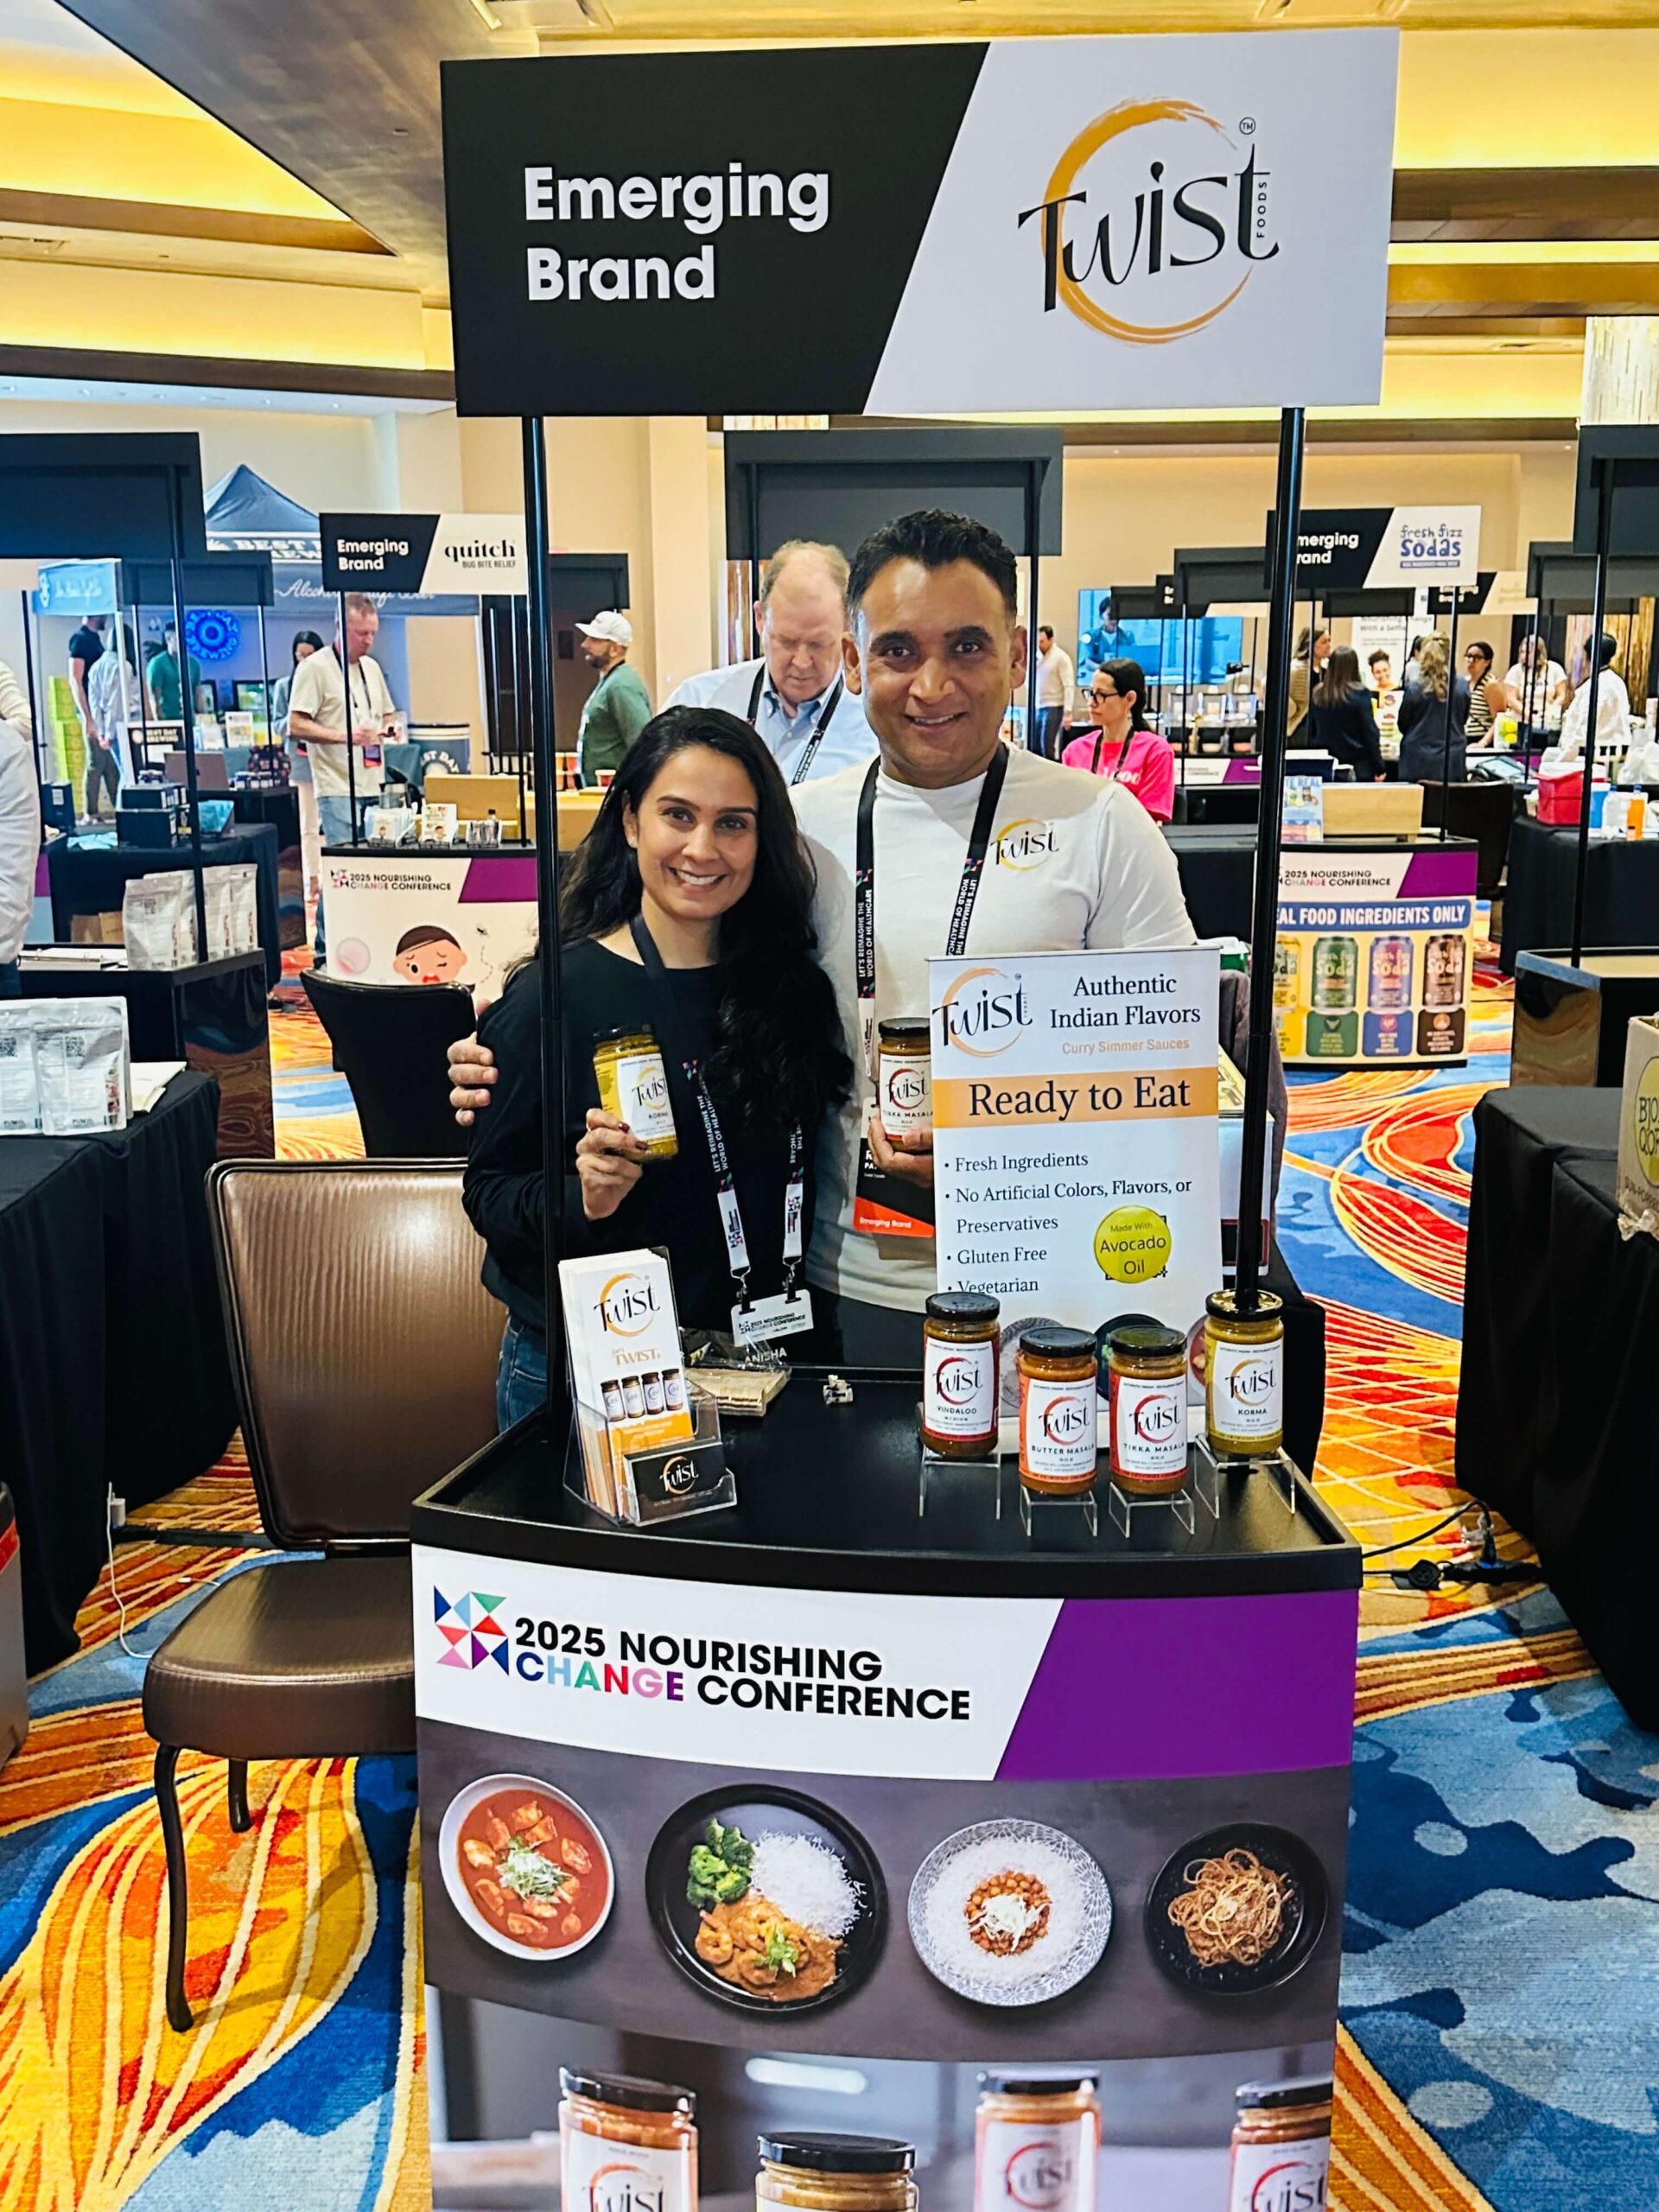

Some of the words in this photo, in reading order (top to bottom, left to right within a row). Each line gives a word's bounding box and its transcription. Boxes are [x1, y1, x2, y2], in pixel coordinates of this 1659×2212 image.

[524, 162, 829, 234] Emerging
[1256, 181, 1268, 238] FOODS
[1018, 143, 1280, 312] Twist
[527, 245, 715, 301] Brand
[1298, 532, 1359, 549] merging
[1401, 524, 1434, 538] fresh
[1438, 524, 1463, 537] fizz
[337, 539, 409, 556] Emerging
[444, 539, 516, 563] quitch
[1296, 550, 1332, 564] rand
[339, 556, 385, 571] Brand
[494, 560, 516, 569] RELIEF
[990, 829, 1059, 865] Twist
[373, 874, 431, 882] NOURISHING
[957, 879, 969, 905] WORLD
[954, 906, 963, 916] OF
[1276, 908, 1296, 925] AL
[1300, 908, 1336, 925] FOOD
[1340, 906, 1430, 925] INGREDIENTS
[1432, 905, 1465, 923] ONLY
[866, 937, 873, 947] OF
[948, 918, 960, 956] HEALTHC
[955, 940, 963, 954] THE
[1073, 974, 1177, 996] Authentic
[931, 982, 1033, 1046] Twist
[1050, 1007, 1119, 1029] Indian
[1124, 1006, 1201, 1026] Flavors
[1062, 1042, 1095, 1055] Curry
[1098, 1039, 1143, 1052] Simmer
[1147, 1039, 1190, 1050] Sauces
[696, 1095, 706, 1109] THE
[969, 1080, 1078, 1121] Ready
[1089, 1084, 1122, 1111] to
[1133, 1076, 1191, 1109] Eat
[1638, 1096, 1659, 1131] BJO
[702, 1109, 716, 1153] REIMAGINE
[715, 1129, 722, 1141] OF
[718, 1141, 728, 1170] WORLD
[955, 1155, 997, 1172] Fresh
[1001, 1153, 1089, 1173] Ingredients
[956, 1188, 979, 1203] No
[983, 1184, 1050, 1201] Artificial
[1054, 1182, 1108, 1198] Colors,
[1112, 1180, 1172, 1196] Flavors,
[1175, 1180, 1192, 1192] or
[859, 1217, 891, 1228] Emerging
[957, 1216, 1058, 1234] Preservatives
[1110, 1224, 1133, 1233] Made
[1135, 1221, 1154, 1230] With
[1099, 1236, 1166, 1254] Avocado
[957, 1249, 1009, 1265] Gluten
[1014, 1247, 1047, 1262] Free
[1123, 1259, 1145, 1274] Oil
[957, 1278, 1039, 1294] Vegetarian
[594, 1282, 660, 1332] Twist
[773, 1314, 805, 1326] CONFERENCE
[615, 1348, 658, 1365] TWIST
[745, 1347, 787, 1363] ANISHA
[932, 1366, 983, 1395] Twist
[1224, 1365, 1277, 1398] Twist
[937, 1405, 977, 1414] VINDALOO
[1128, 1402, 1181, 1435] Twist
[1039, 1403, 1090, 1437] Twist
[1032, 1445, 1064, 1454] BUTTER
[1067, 1444, 1095, 1454] MASALA
[1123, 1443, 1151, 1452] TIKKA
[1155, 1442, 1185, 1452] MASALA
[659, 1460, 699, 1491] Twist
[514, 1616, 606, 1658] 2025
[620, 1630, 882, 1681] NOURISHING
[516, 1651, 684, 1702] CHANGE
[696, 1675, 970, 1721] CONFERENCE
